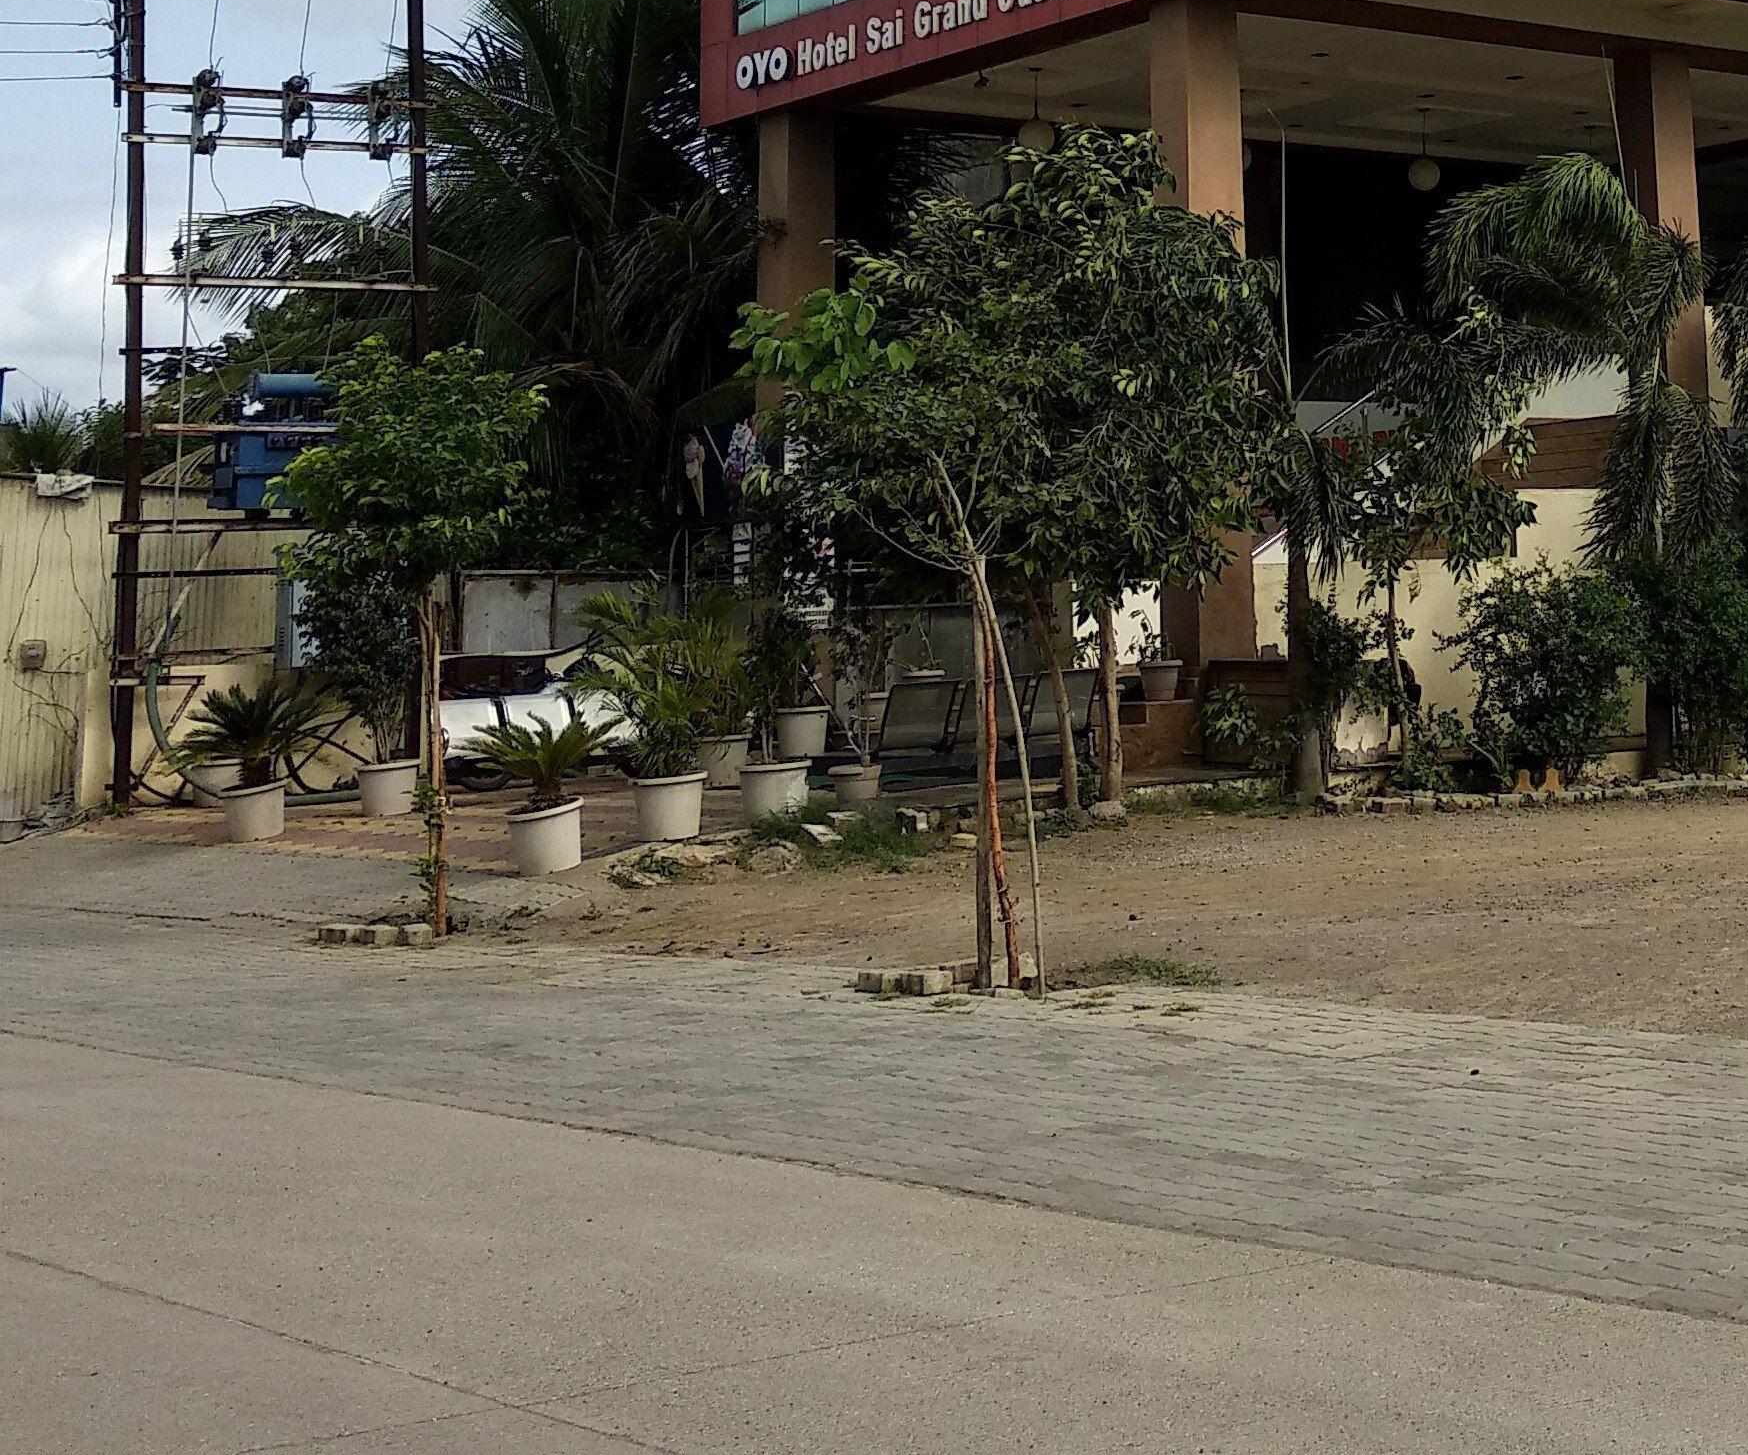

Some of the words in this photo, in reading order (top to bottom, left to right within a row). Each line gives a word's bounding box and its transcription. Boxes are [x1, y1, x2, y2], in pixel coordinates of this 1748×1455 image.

[735, 45, 788, 90] OYO
[796, 24, 857, 76] Hotel
[865, 9, 904, 54] Sai
